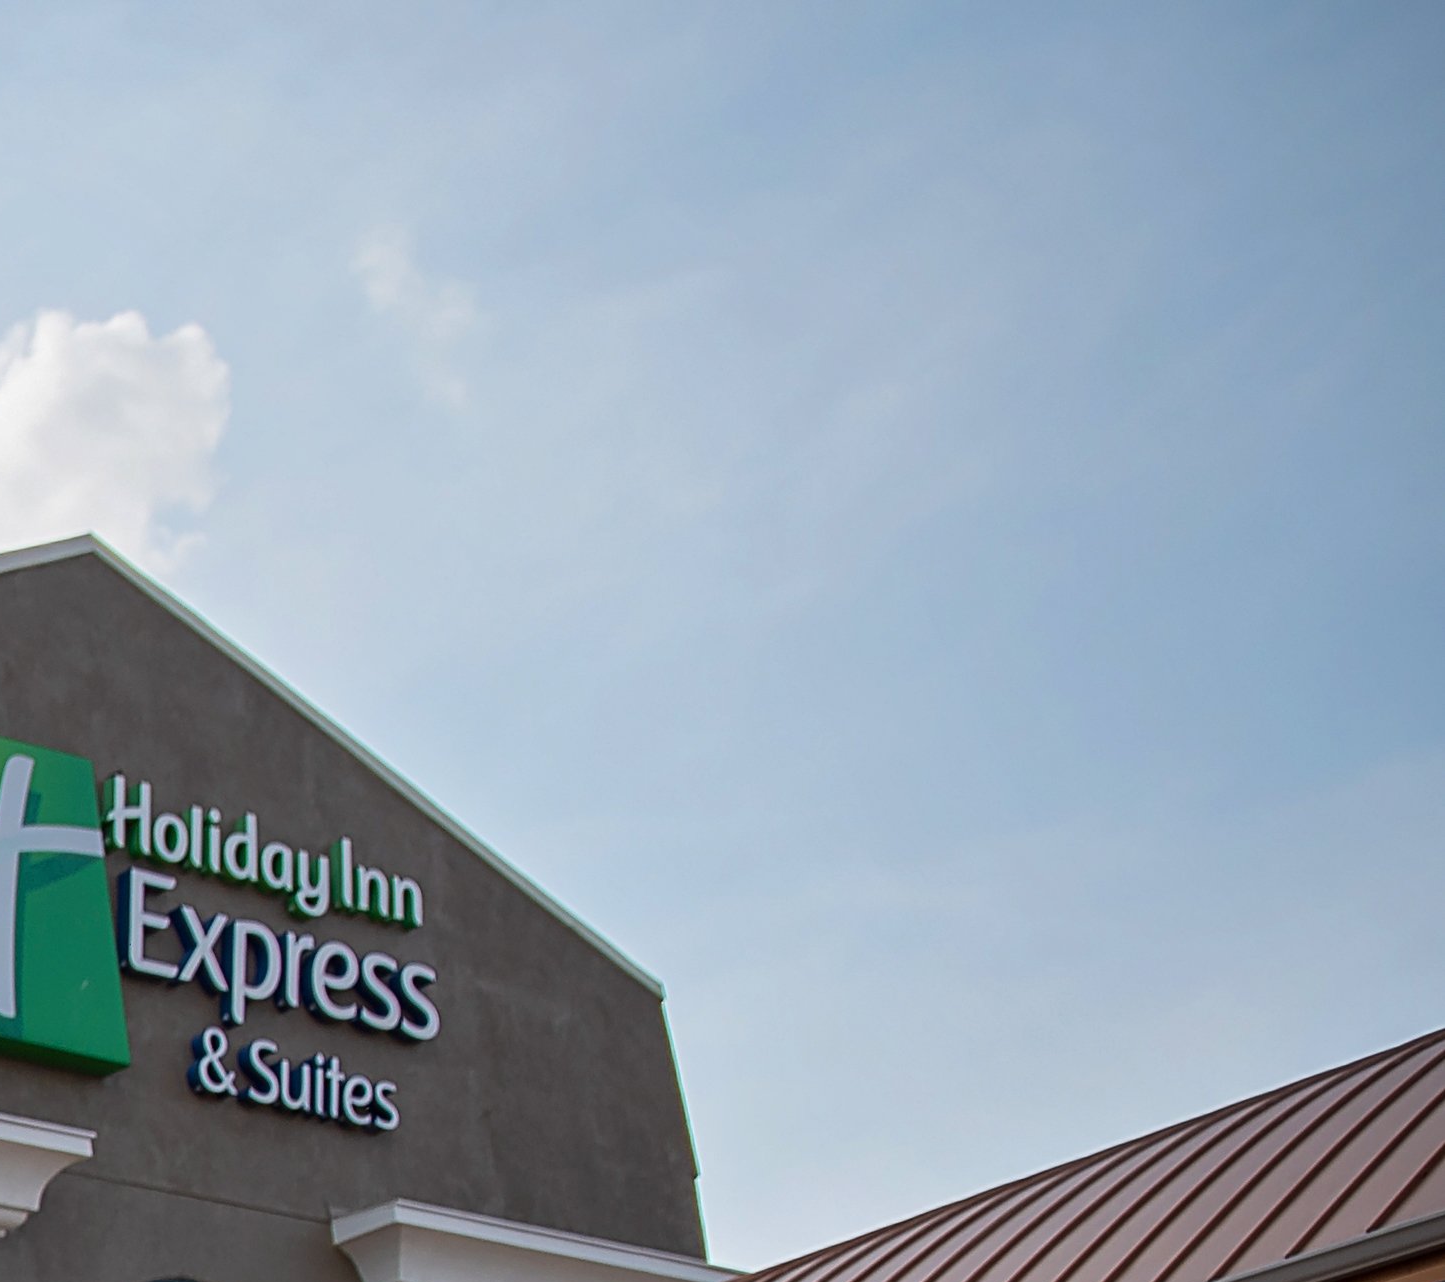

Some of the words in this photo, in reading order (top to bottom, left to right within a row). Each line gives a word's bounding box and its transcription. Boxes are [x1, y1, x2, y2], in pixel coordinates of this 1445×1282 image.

[103, 771, 328, 918] Holiday
[336, 836, 424, 929] Inn
[122, 866, 442, 1042] Express
[191, 1026, 238, 1098] &
[241, 1038, 401, 1132] Suites
